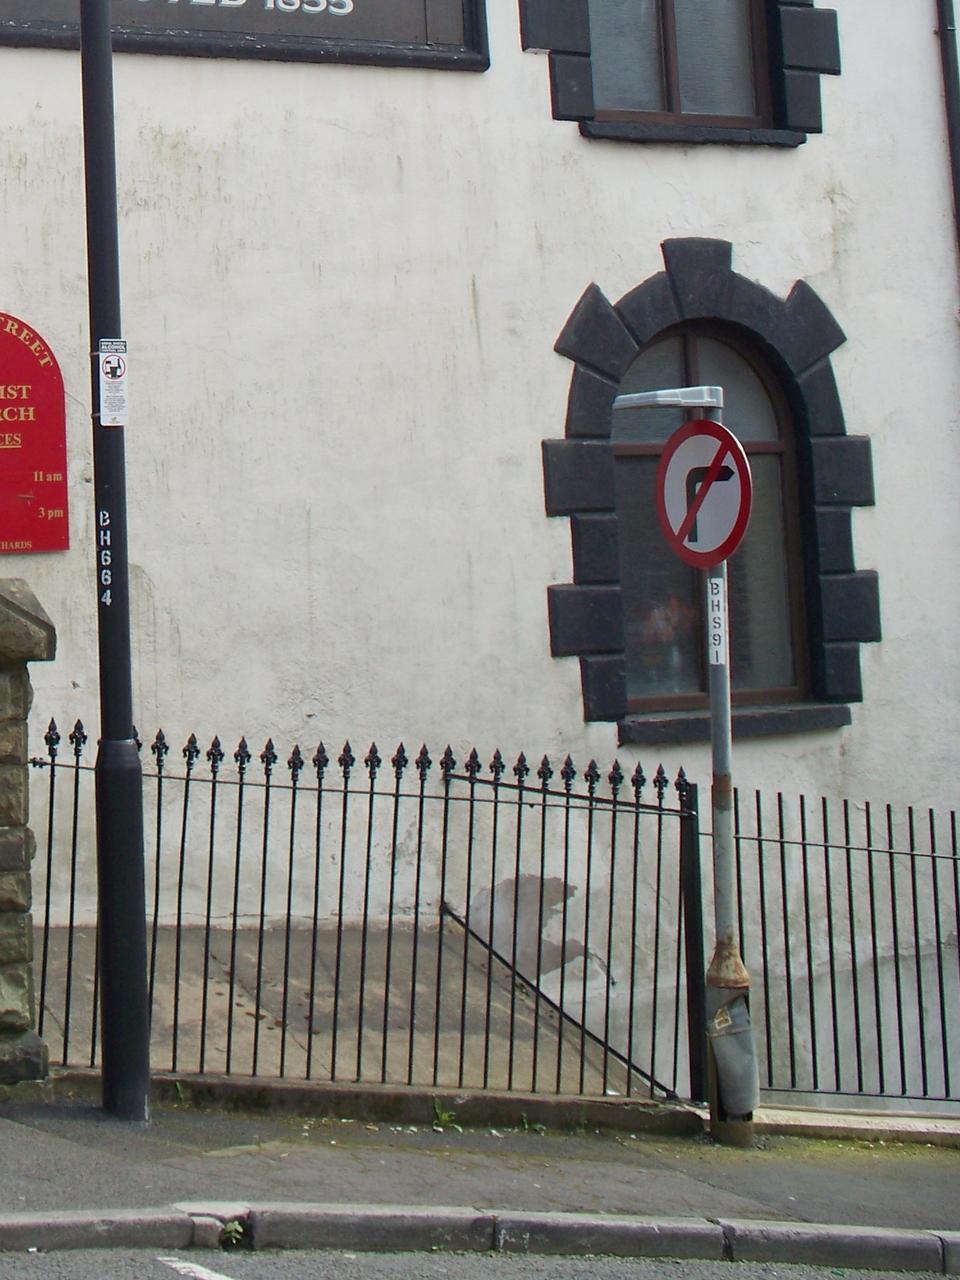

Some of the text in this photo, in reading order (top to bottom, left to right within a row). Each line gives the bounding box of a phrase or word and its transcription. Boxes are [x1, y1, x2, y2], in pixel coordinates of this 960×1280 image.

[33, 471, 63, 482] 11 am
[38, 507, 64, 520] 3 pm
